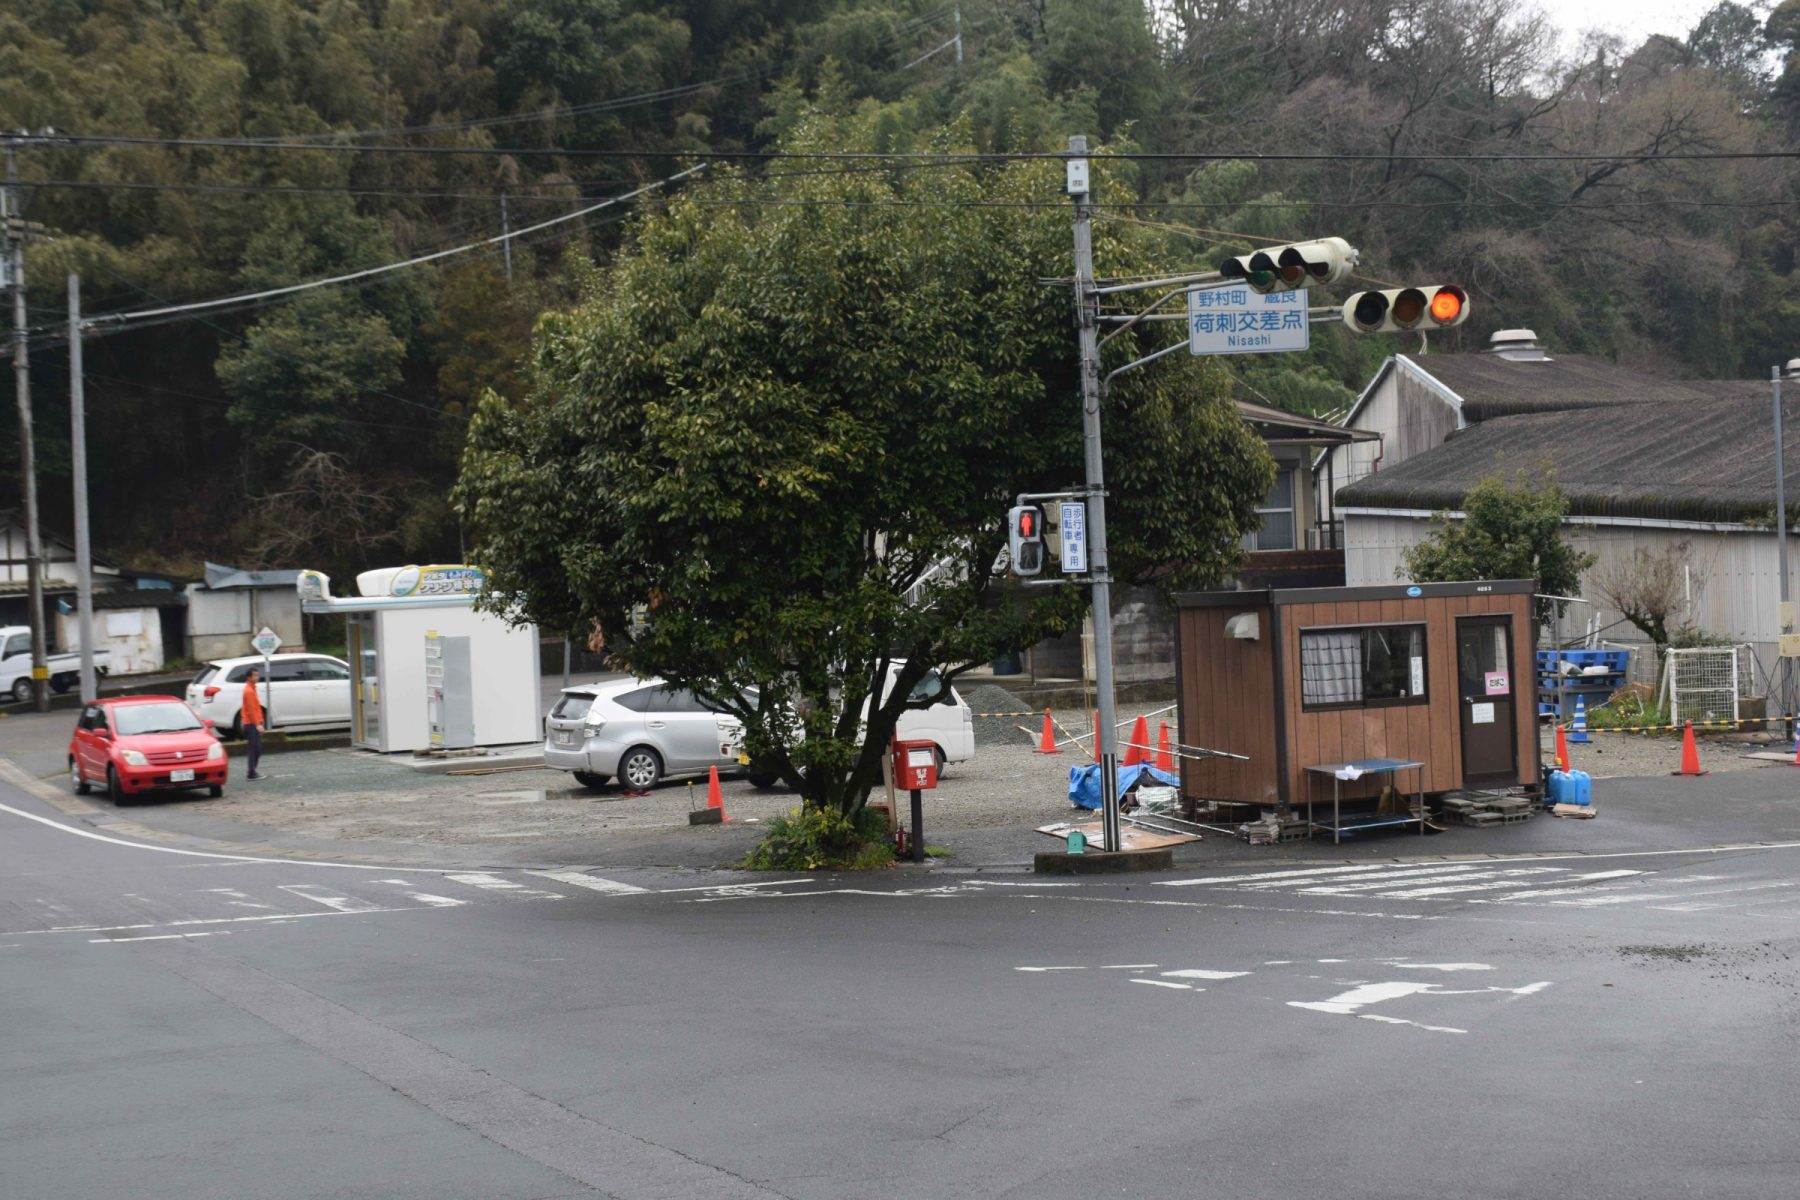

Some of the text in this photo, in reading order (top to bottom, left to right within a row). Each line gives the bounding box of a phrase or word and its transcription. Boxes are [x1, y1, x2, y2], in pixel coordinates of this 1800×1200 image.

[1198, 290, 1247, 307] 野村町
[1194, 309, 1302, 334] 荷刺交差点
[1228, 333, 1271, 346] Nisashi
[1063, 508, 1073, 540] 自転車
[1073, 508, 1082, 540] 歩行者
[1070, 543, 1078, 566] 専用
